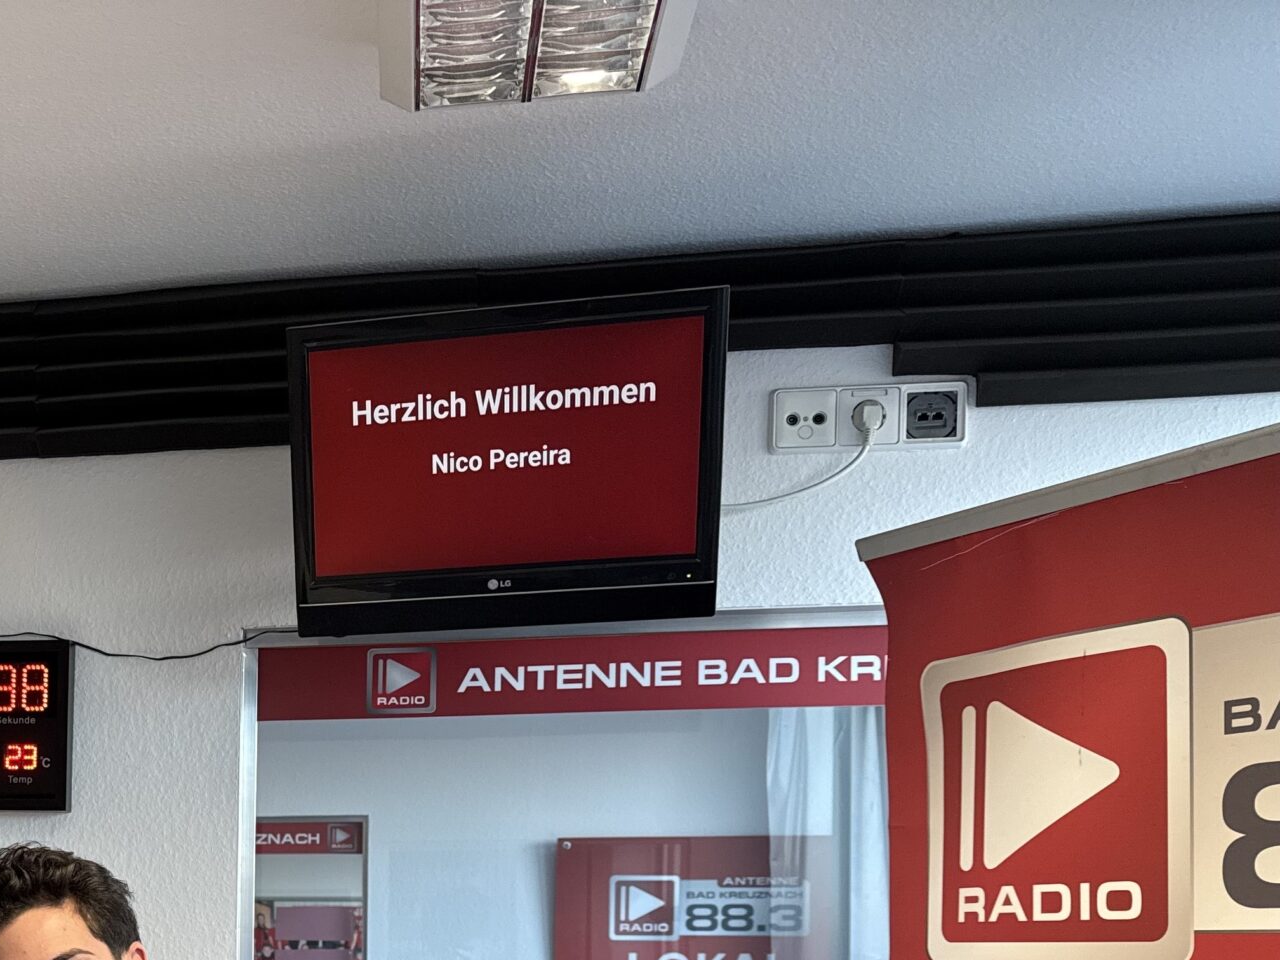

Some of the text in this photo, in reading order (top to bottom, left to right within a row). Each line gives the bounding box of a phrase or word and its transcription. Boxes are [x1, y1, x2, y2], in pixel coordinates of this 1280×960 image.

[351, 380, 657, 427] Herzlich Willkommen
[431, 444, 572, 475] Nico Pereira
[499, 579, 512, 589] LG
[457, 654, 888, 693] ANTENNE BAD KR
[377, 695, 425, 707] RADIO
[8, 774, 33, 786] Temp
[722, 876, 800, 887] ANTENNE
[686, 890, 805, 900] BAD KREUZNACH
[957, 881, 1143, 924] RADIO
[685, 903, 804, 933] 88.3
[619, 922, 670, 933] RADIO
